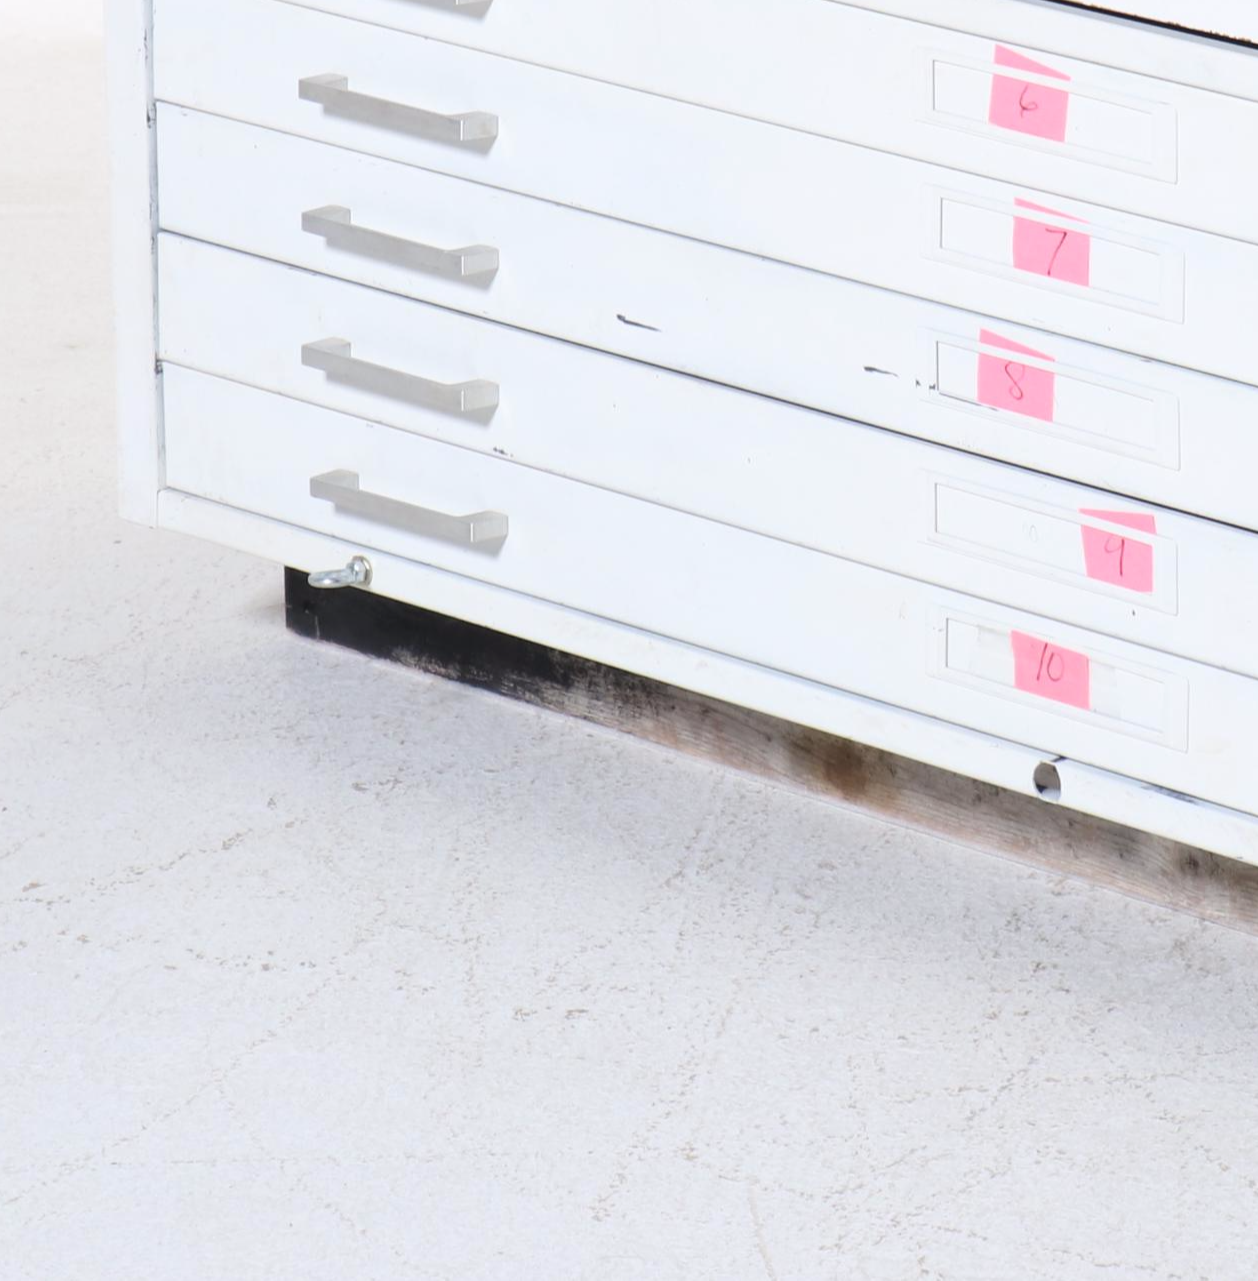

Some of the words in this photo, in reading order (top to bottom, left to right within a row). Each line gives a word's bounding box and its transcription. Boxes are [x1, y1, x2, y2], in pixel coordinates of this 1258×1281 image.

[1020, 84, 1039, 116] 6
[1045, 228, 1067, 275] 7
[1005, 361, 1025, 402] 8
[1103, 536, 1126, 577] 9
[1036, 641, 1065, 683] 10
